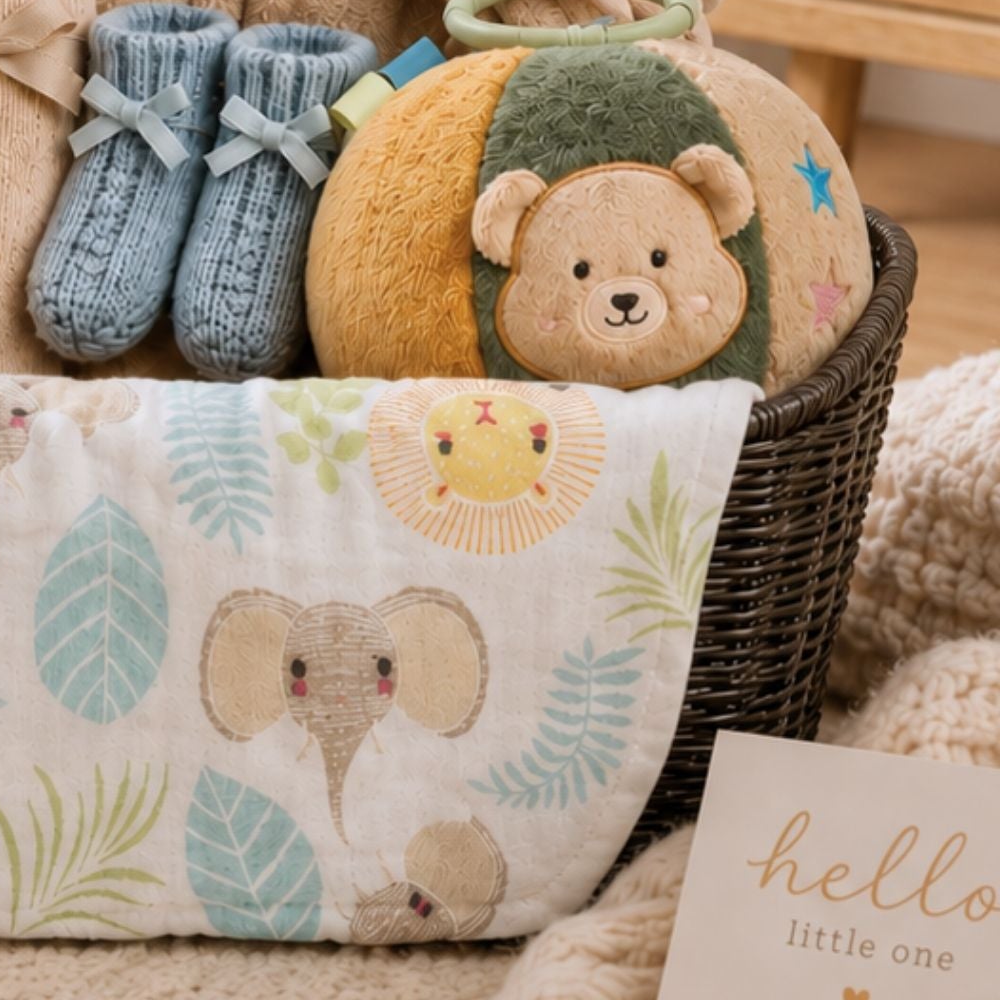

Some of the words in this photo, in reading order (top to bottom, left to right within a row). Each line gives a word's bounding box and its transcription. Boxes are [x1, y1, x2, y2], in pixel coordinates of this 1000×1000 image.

[747, 811, 1000, 922] hello
[786, 919, 876, 959] little
[891, 943, 954, 972] one
